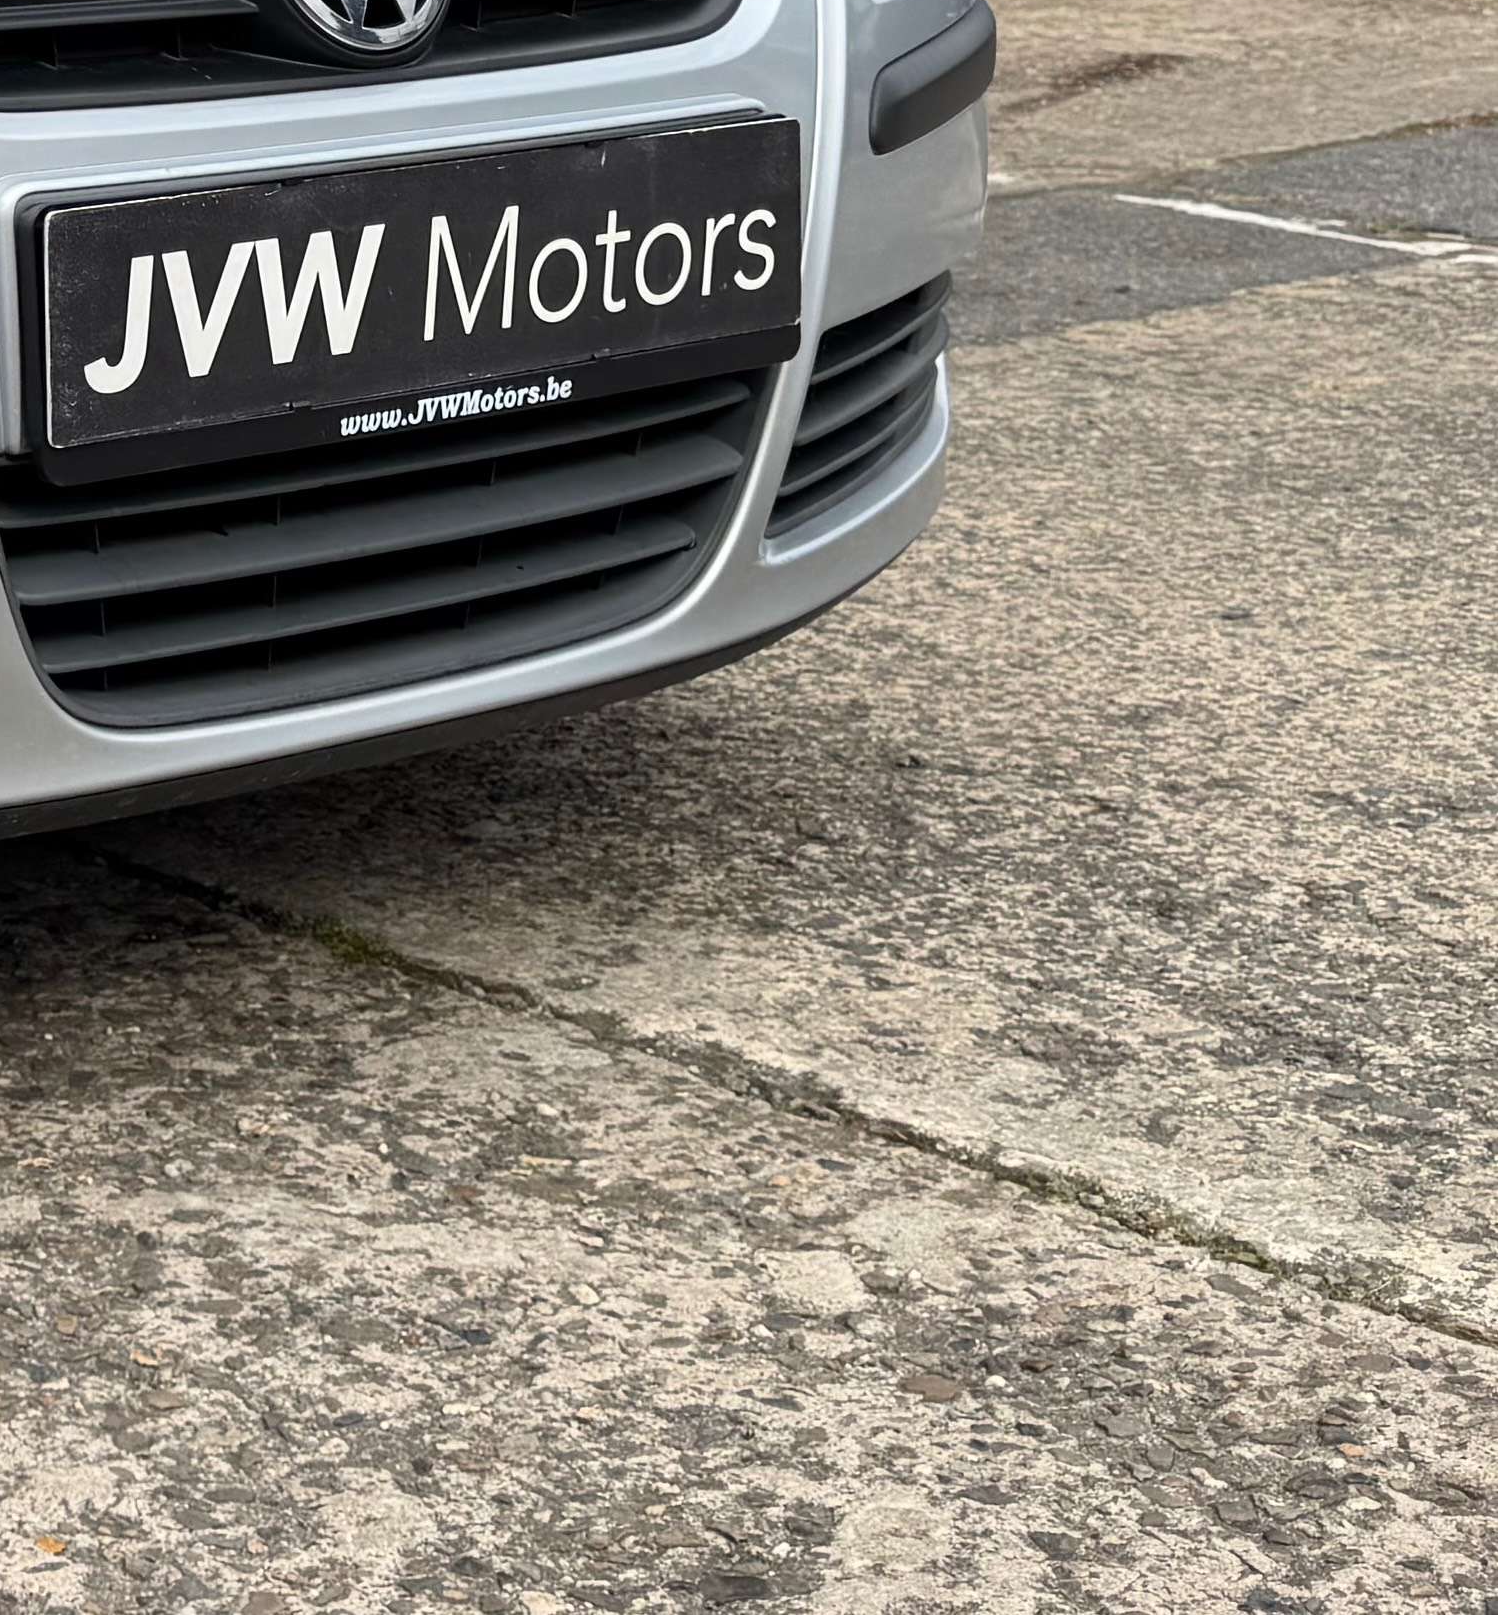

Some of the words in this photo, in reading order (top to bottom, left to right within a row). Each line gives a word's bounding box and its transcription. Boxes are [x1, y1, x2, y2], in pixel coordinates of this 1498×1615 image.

[84, 222, 386, 395] JVW
[423, 205, 778, 341] Motors
[339, 375, 573, 437] www.JVWMotors.be
